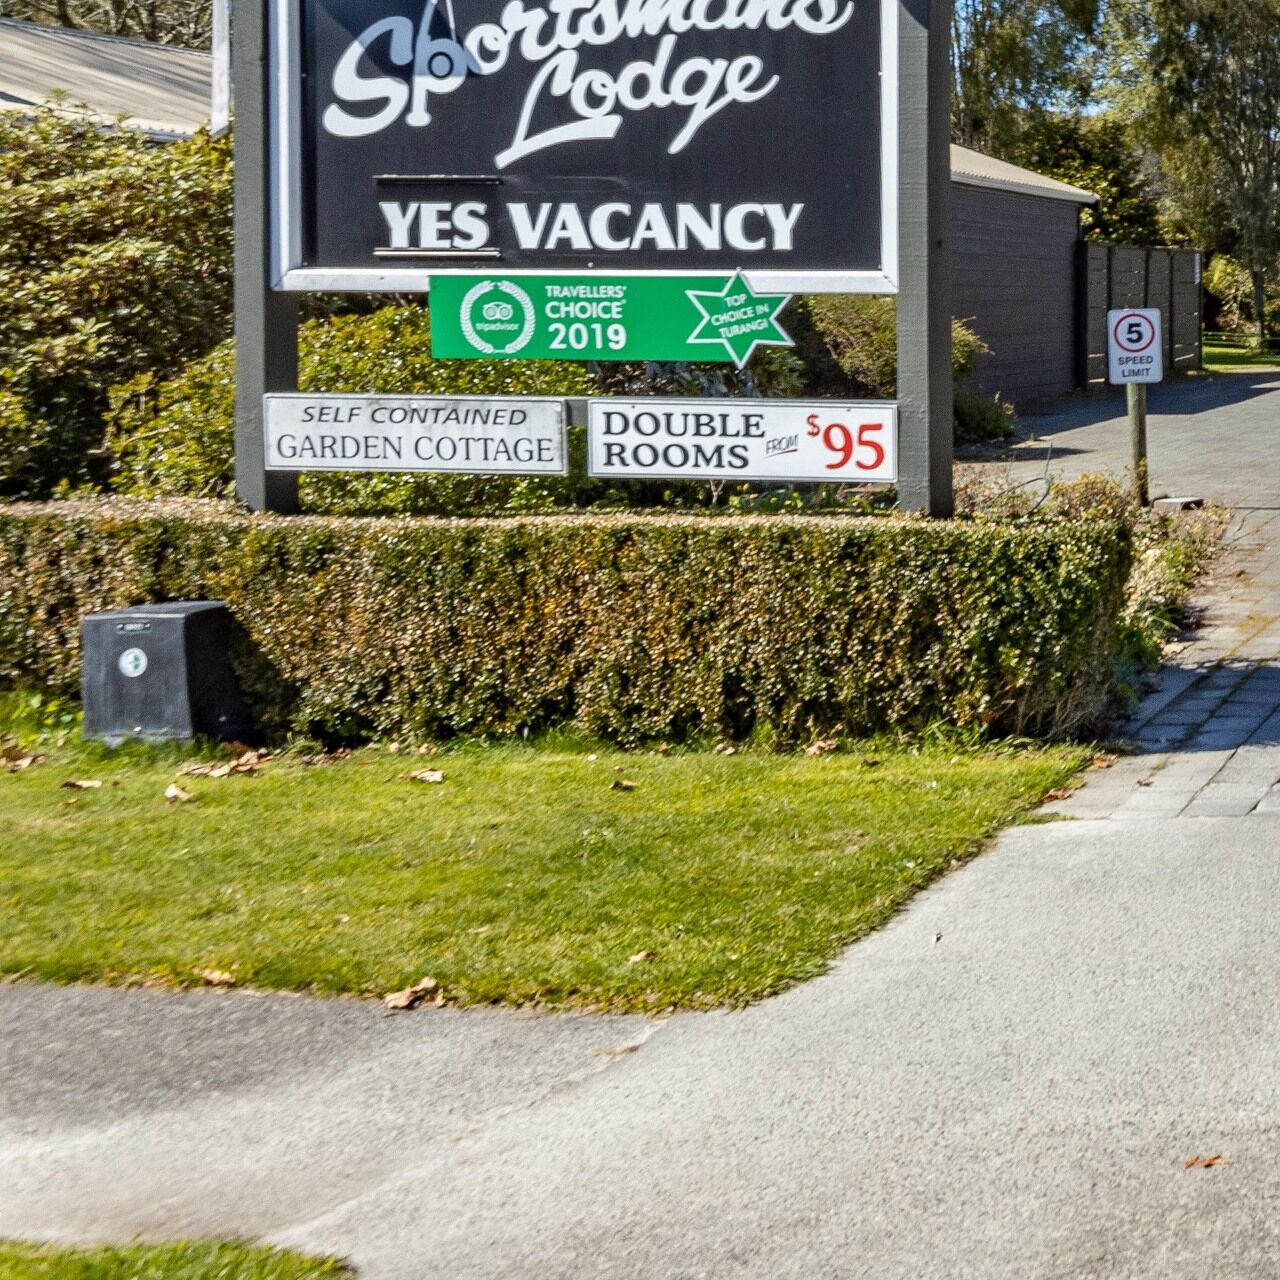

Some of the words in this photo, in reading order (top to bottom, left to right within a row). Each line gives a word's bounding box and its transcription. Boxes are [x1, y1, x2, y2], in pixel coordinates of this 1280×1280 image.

[494, 35, 779, 170] Lodge
[379, 201, 489, 250] YES
[507, 202, 804, 251] VACANCY
[545, 285, 627, 298] TRAVELLERS'
[724, 293, 747, 307] TOP
[711, 306, 755, 326] CHOICE
[755, 303, 769, 315] IN
[548, 322, 627, 350] 2019
[1126, 323, 1143, 343] 5
[1118, 356, 1153, 365] SPEED
[1121, 368, 1151, 377] LIMIT
[301, 406, 361, 423] SELF
[371, 407, 527, 425] CONTAINED
[602, 411, 766, 438] DOUBLE
[277, 433, 402, 460] GARDEN
[414, 436, 554, 463] COTTAGE
[766, 434, 799, 454] FROM
[806, 413, 885, 470] $95
[603, 442, 750, 469] ROOMS
